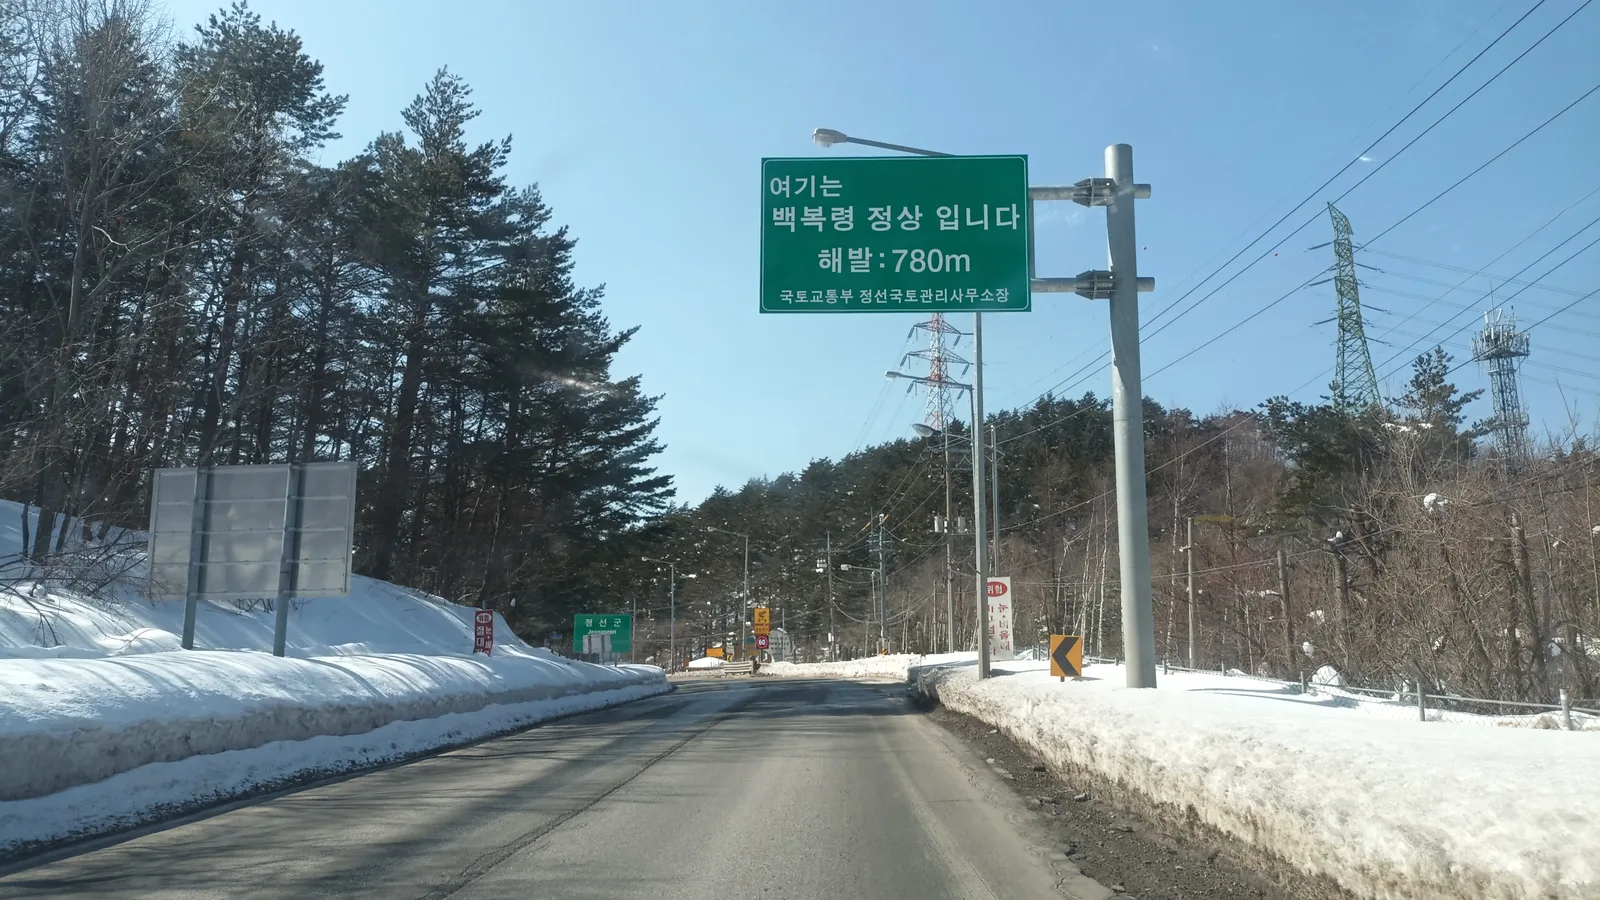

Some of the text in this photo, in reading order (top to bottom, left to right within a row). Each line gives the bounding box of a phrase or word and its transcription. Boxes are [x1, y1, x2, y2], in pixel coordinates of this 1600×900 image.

[771, 176, 842, 197] 여기는
[773, 204, 1019, 232] 백복령 정상 입니다
[781, 288, 1008, 303] 국토교통부 정선국토관리사무소장
[585, 618, 621, 627] 정선군
